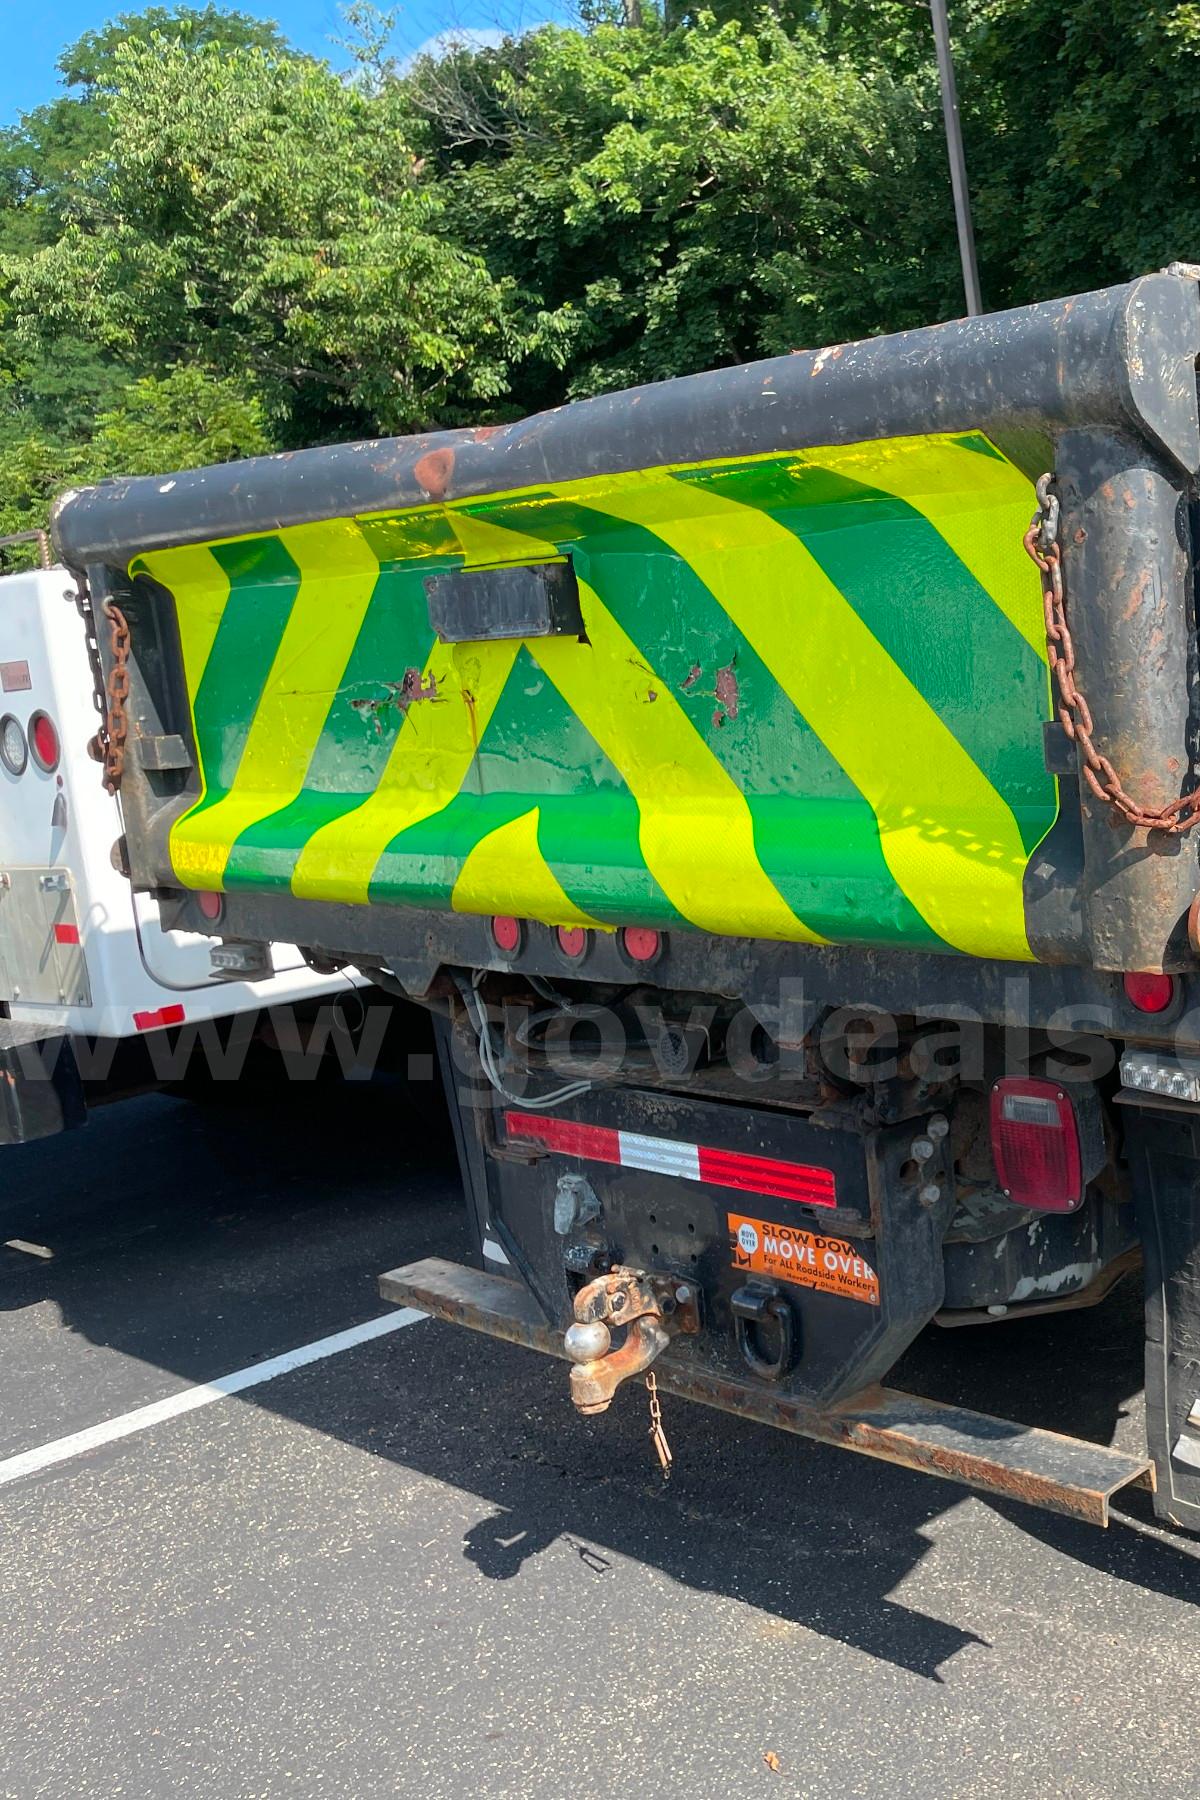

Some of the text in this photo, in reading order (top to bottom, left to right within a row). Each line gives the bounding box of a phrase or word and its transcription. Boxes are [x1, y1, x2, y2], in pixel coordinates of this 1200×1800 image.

[763, 1225, 859, 1258] SLOW DOW
[764, 1237, 875, 1281] MOVE OVER
[764, 1255, 777, 1266] For
[780, 1258, 794, 1270] ALL
[797, 1262, 836, 1282] Roadside
[838, 1274, 876, 1293] Workers
